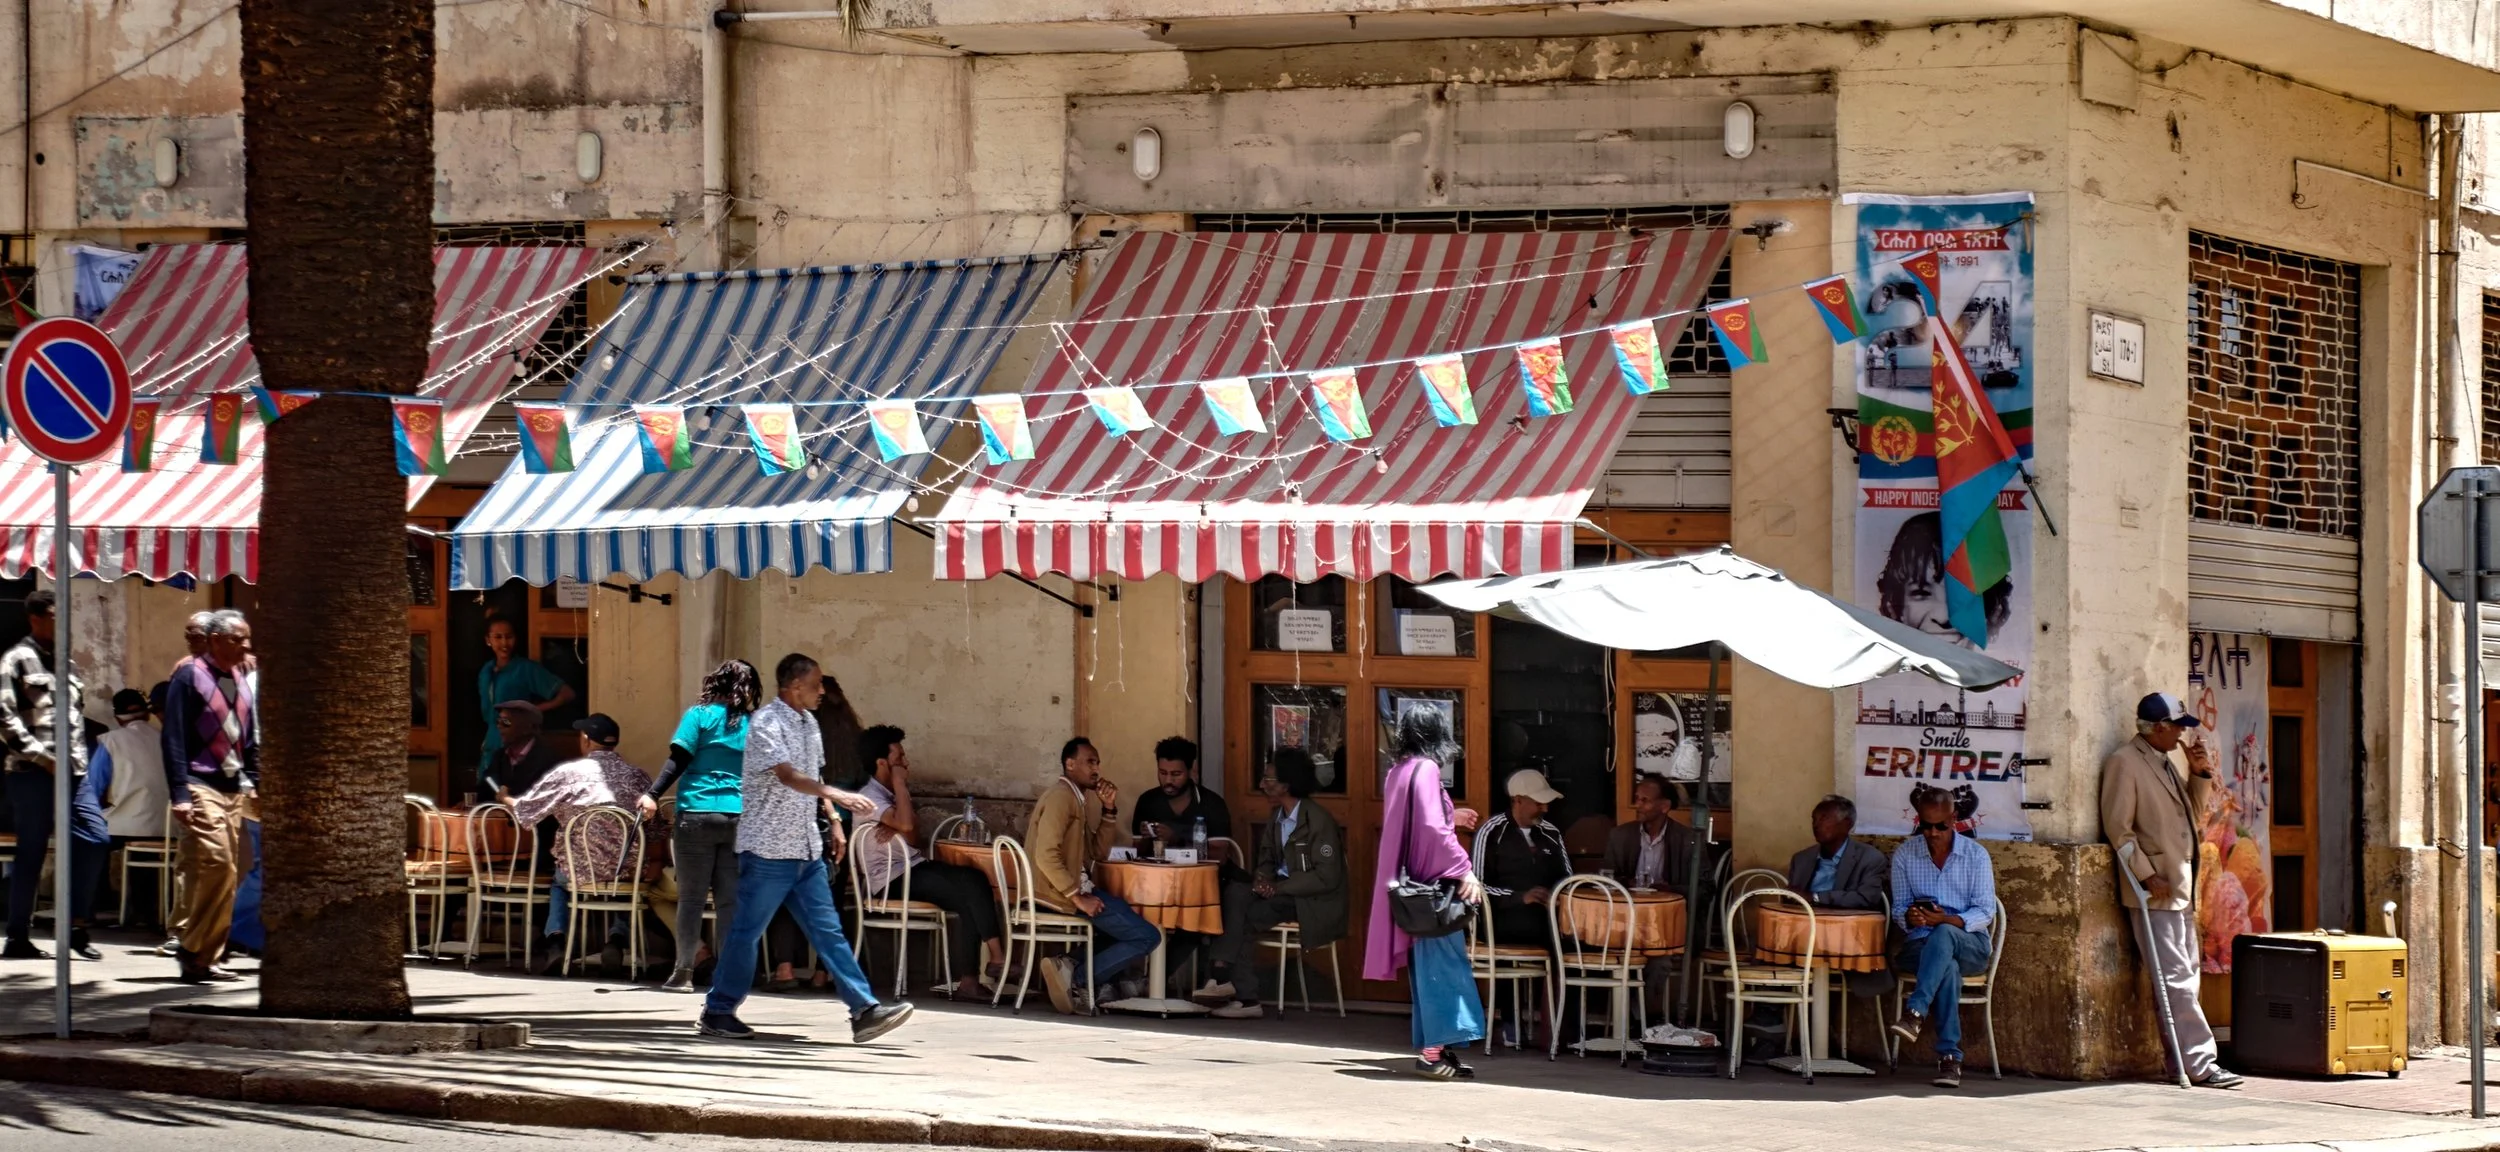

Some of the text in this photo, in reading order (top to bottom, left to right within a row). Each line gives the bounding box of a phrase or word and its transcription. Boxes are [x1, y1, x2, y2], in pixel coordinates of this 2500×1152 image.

[1955, 256, 1979, 267] 1991
[1874, 490, 1909, 506] HAPPY
[1920, 727, 1971, 748] Smile
[1864, 746, 2023, 782] ERITREA
